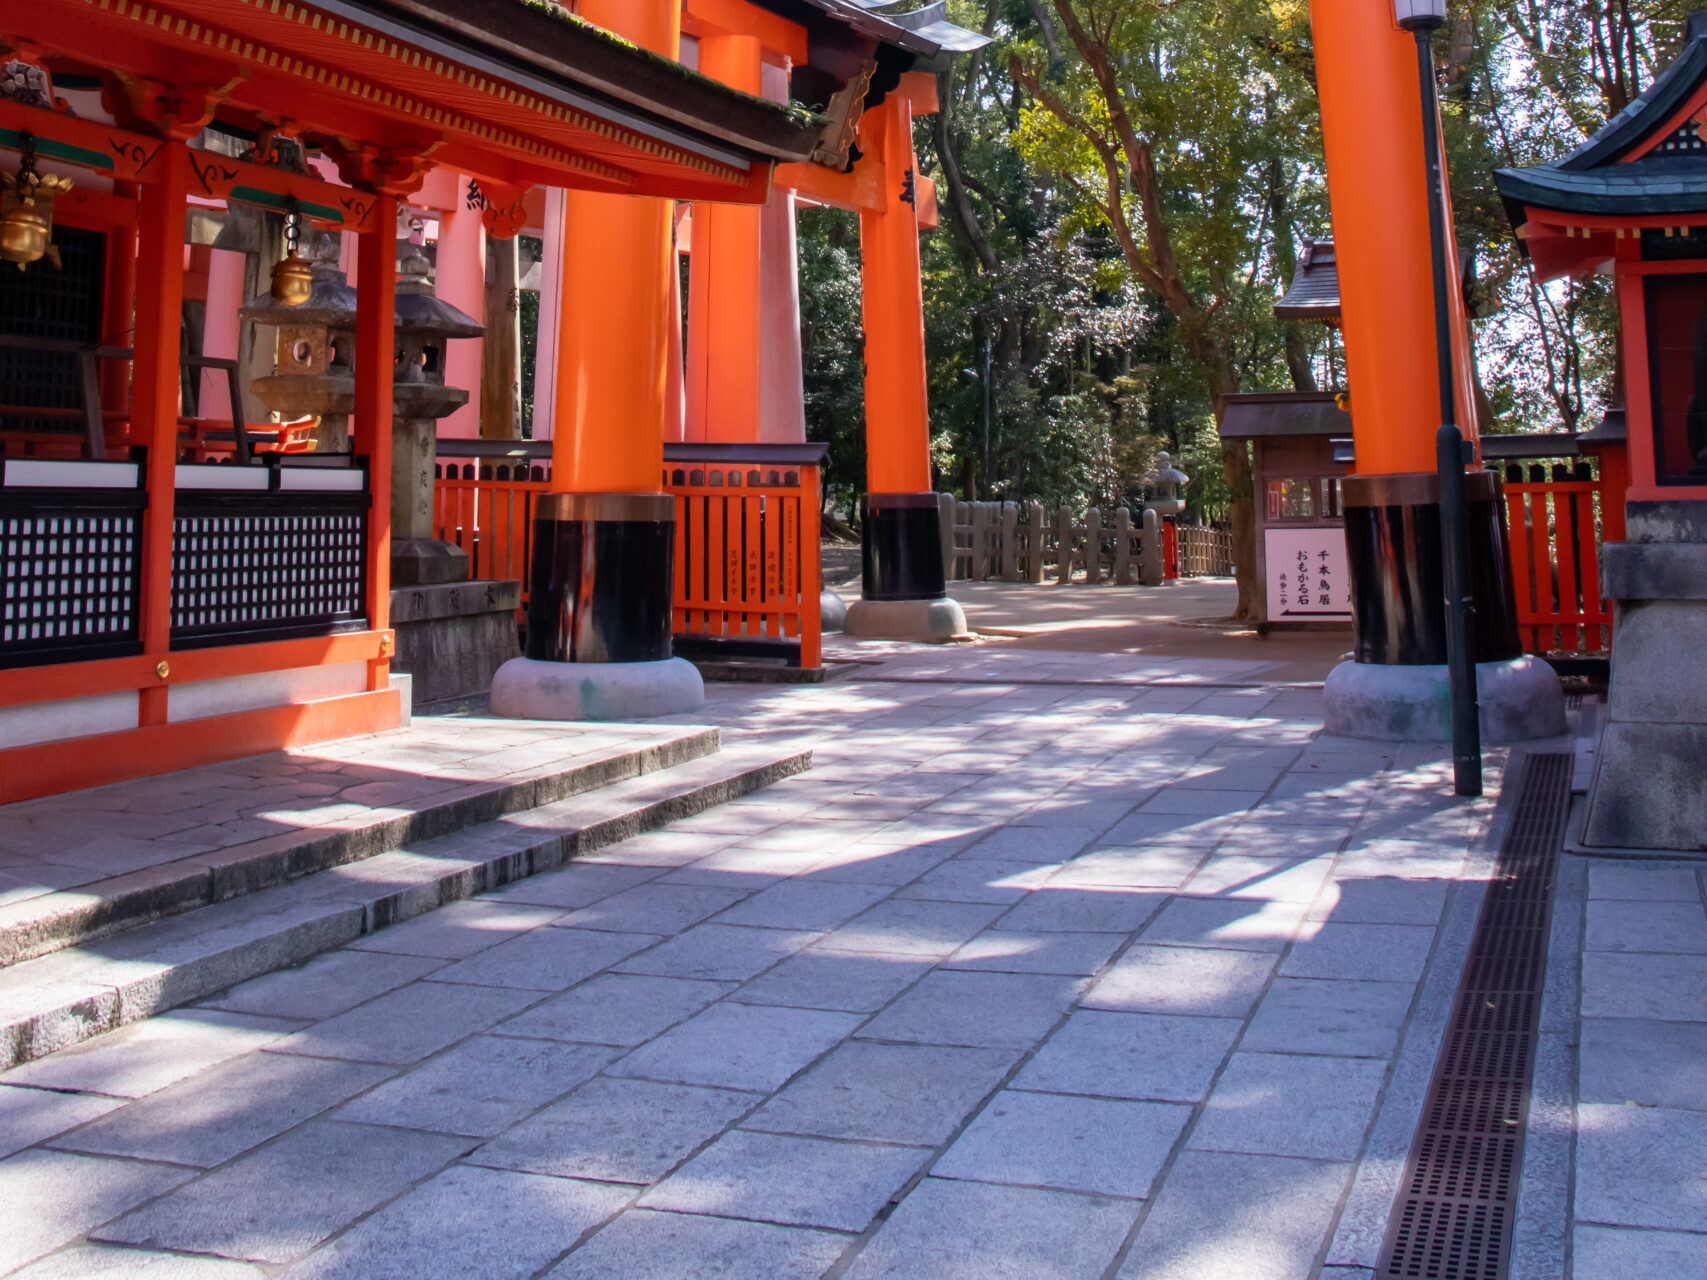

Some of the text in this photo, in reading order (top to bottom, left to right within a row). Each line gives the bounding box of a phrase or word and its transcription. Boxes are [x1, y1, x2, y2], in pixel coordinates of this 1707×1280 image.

[1297, 550, 1309, 605] おもかる石
[1318, 550, 1331, 605] 千本鳥居
